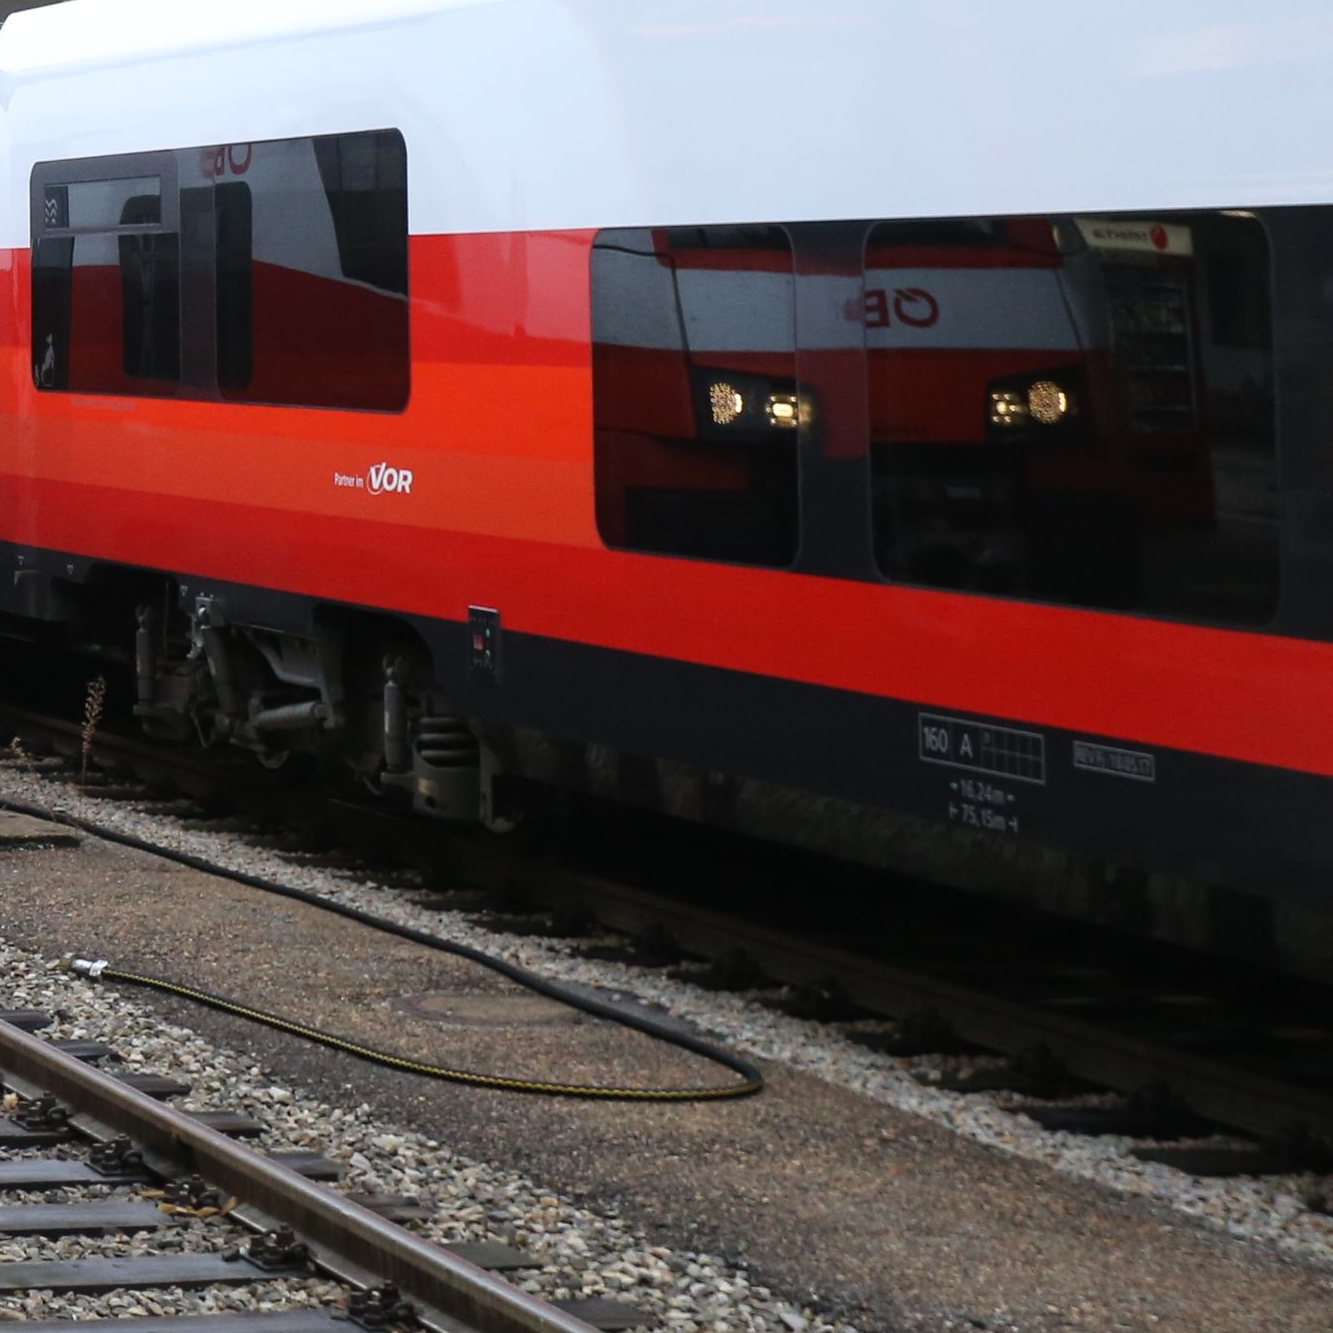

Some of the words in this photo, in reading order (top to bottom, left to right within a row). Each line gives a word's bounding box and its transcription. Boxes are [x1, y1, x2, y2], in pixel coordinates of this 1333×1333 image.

[334, 472, 355, 487] Partner
[369, 462, 413, 494] VOR
[923, 726, 948, 753] 160
[959, 733, 973, 757] A
